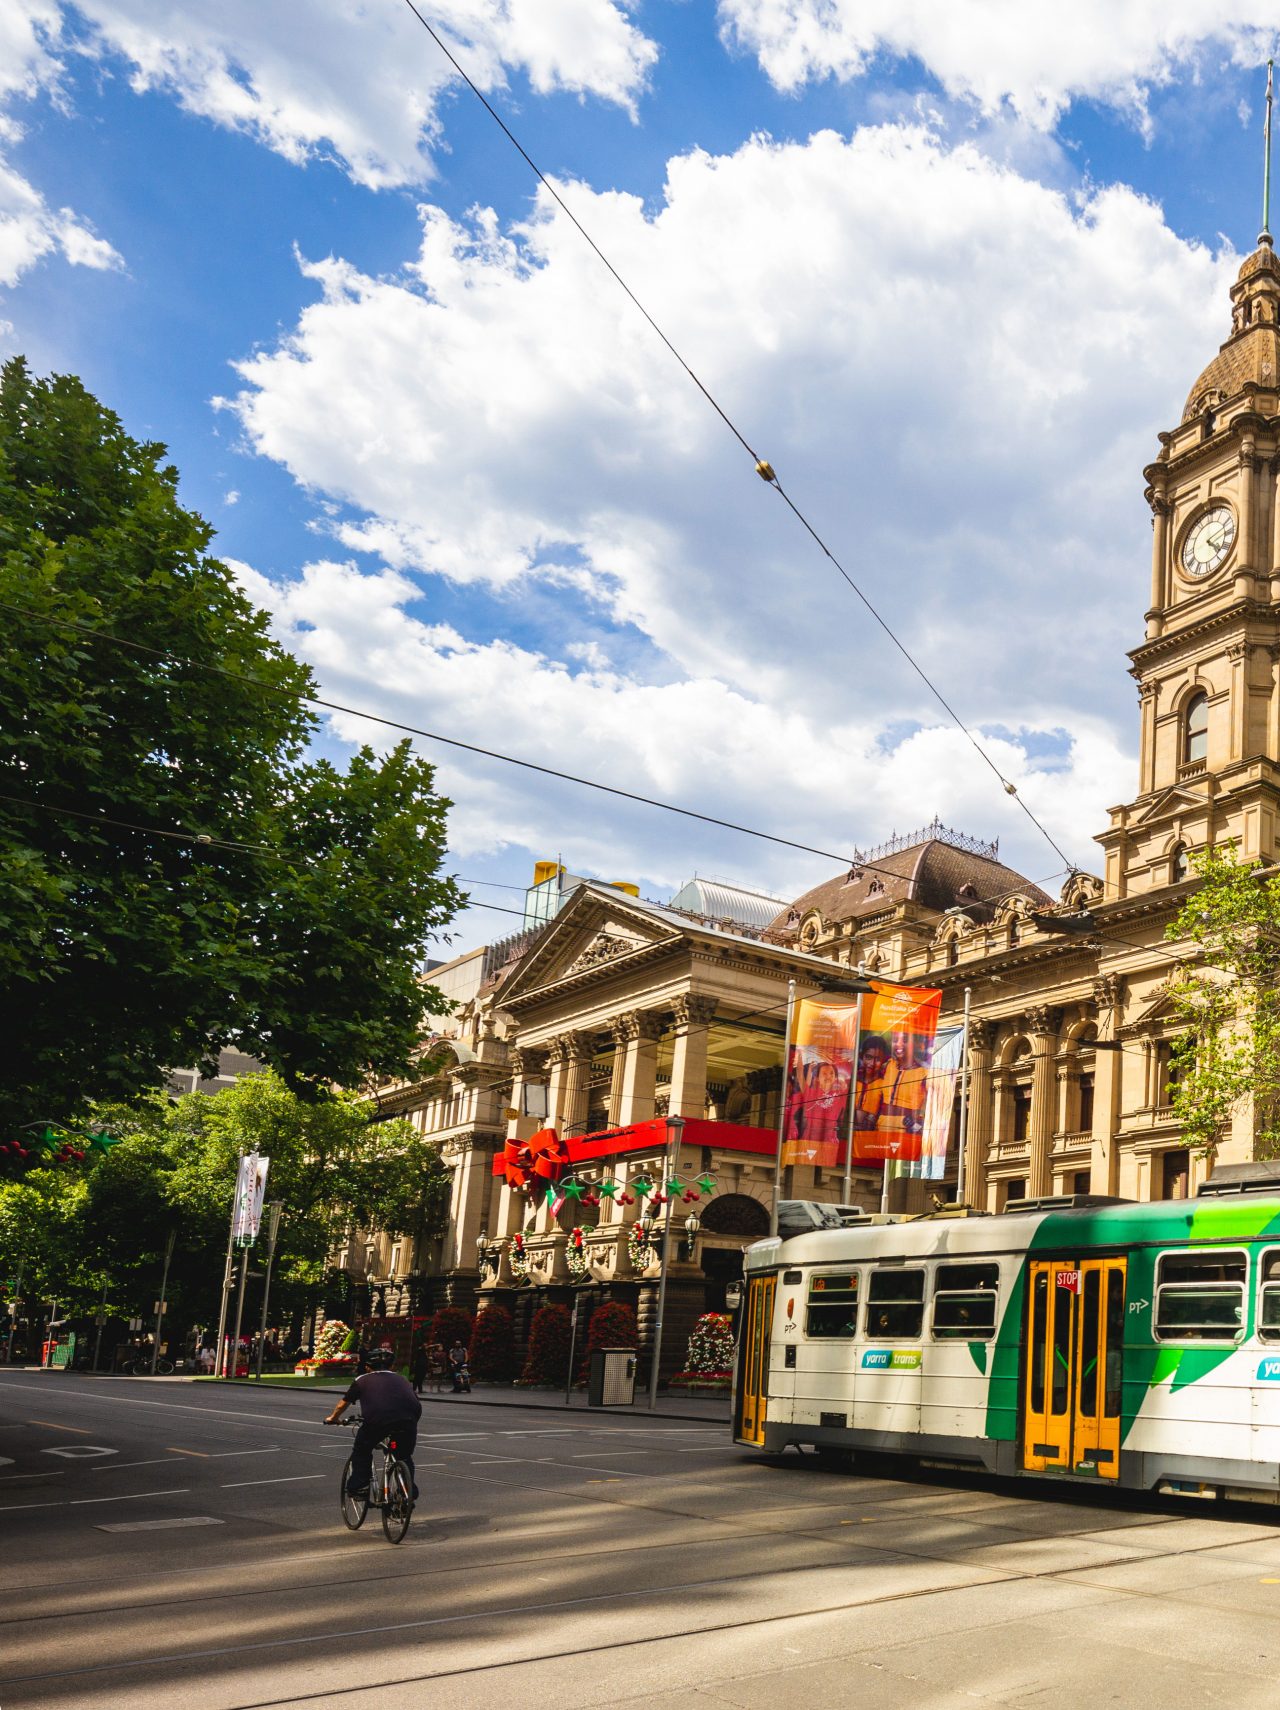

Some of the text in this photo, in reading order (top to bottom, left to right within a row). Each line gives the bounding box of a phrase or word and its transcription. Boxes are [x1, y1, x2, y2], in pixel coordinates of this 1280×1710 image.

[1057, 1272, 1078, 1285] STOP
[866, 1354, 917, 1366] yarra trams
